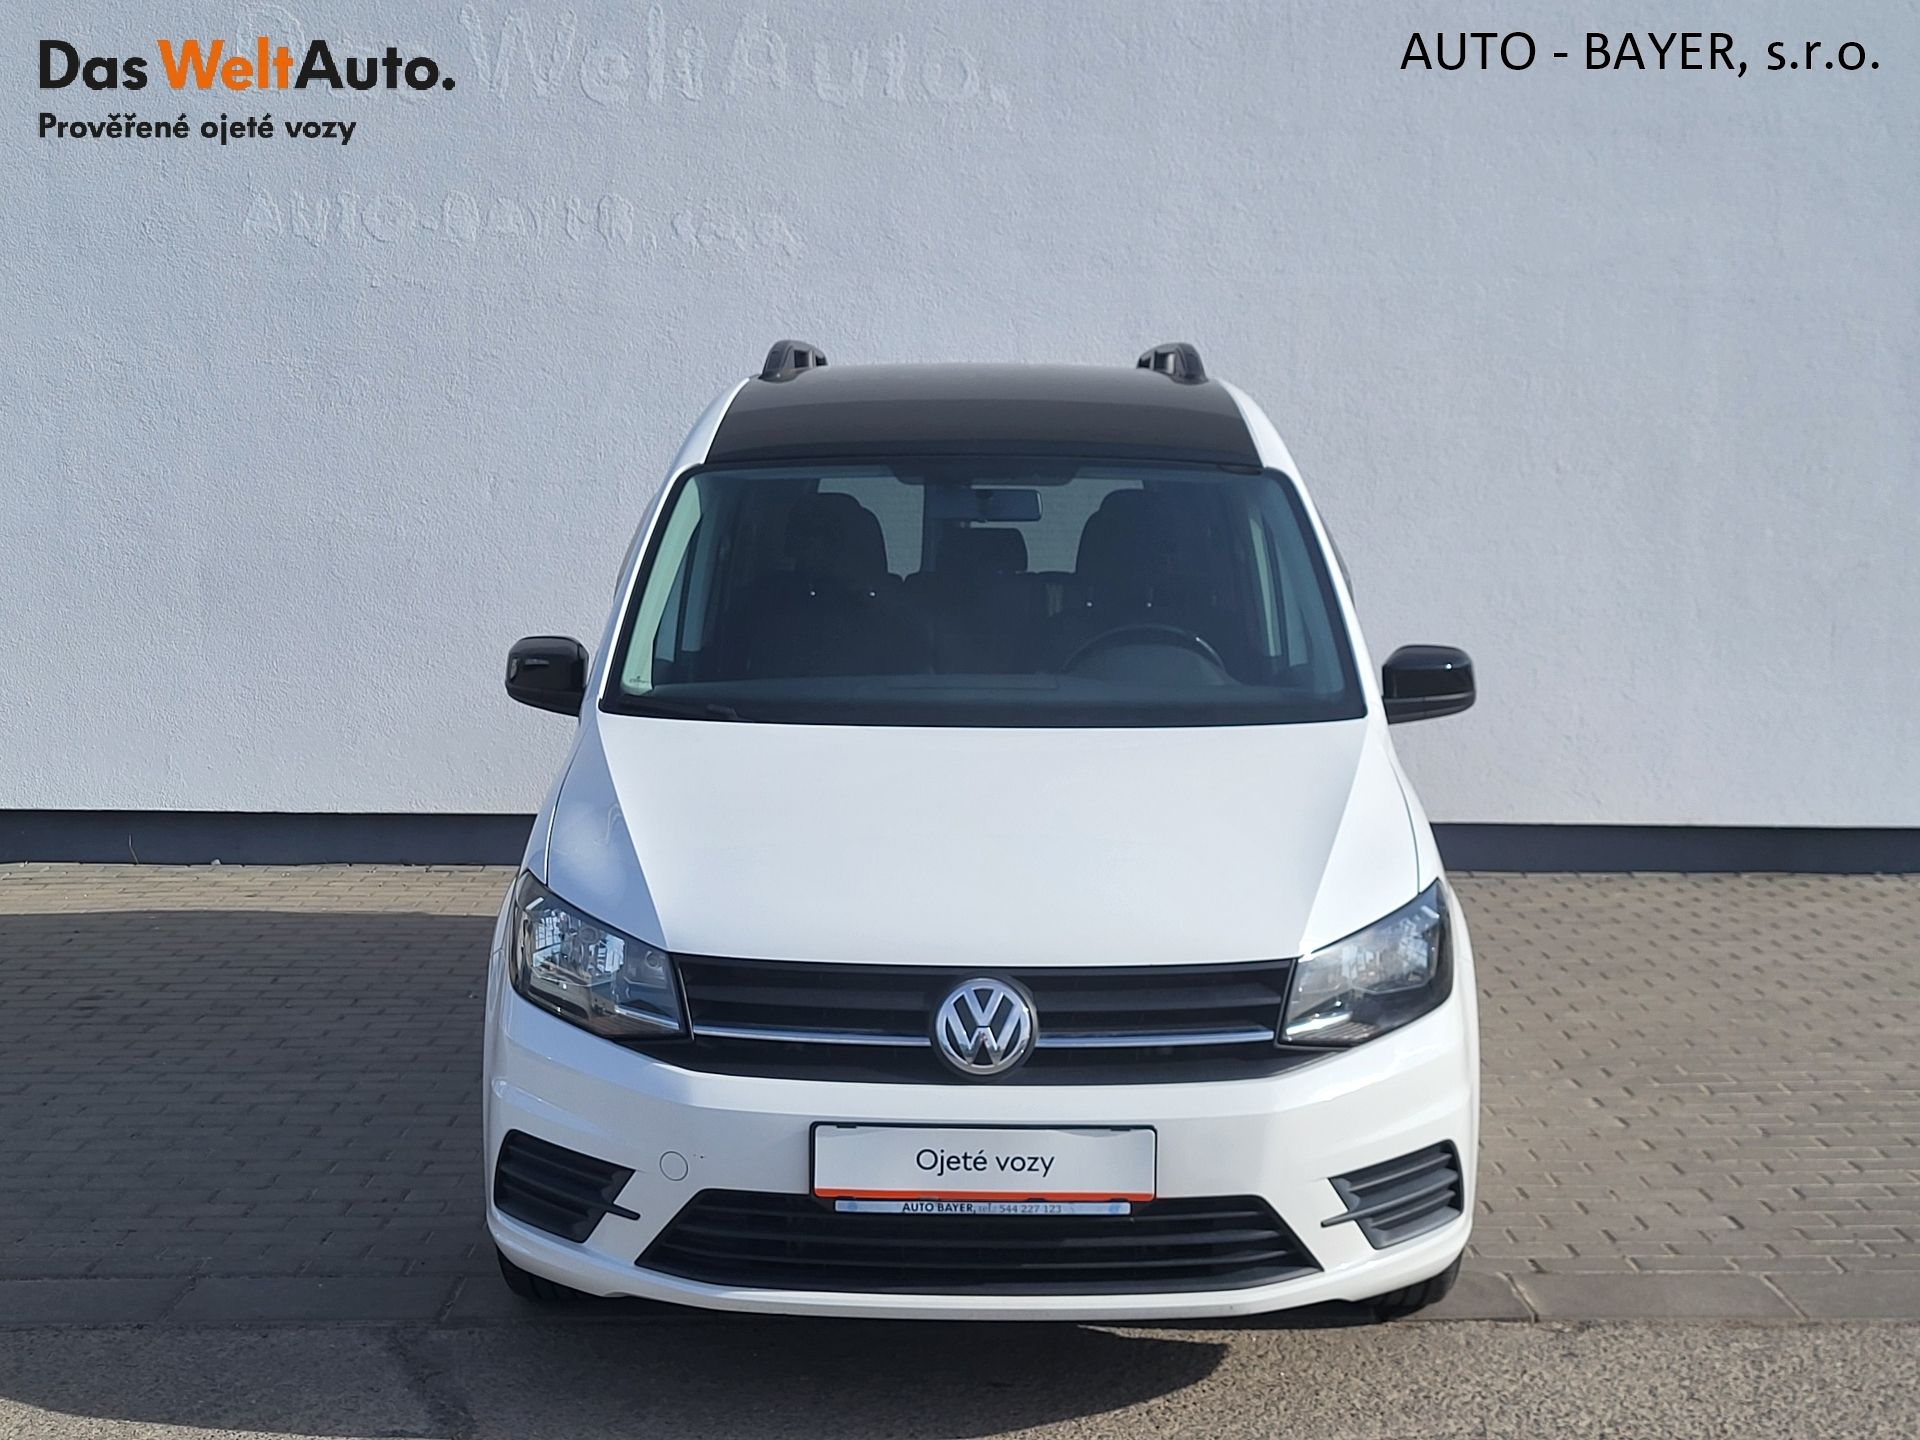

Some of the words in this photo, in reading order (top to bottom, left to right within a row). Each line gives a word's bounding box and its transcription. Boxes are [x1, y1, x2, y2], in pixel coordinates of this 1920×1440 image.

[916, 1148, 988, 1176] Ojeté
[996, 1156, 1055, 1178] vozy
[902, 1202, 934, 1212] AUTO
[937, 1203, 976, 1214] BAYER,
[1000, 1205, 1018, 1213] 544
[1021, 1205, 1040, 1213] 227
[1044, 1205, 1062, 1214] 123
